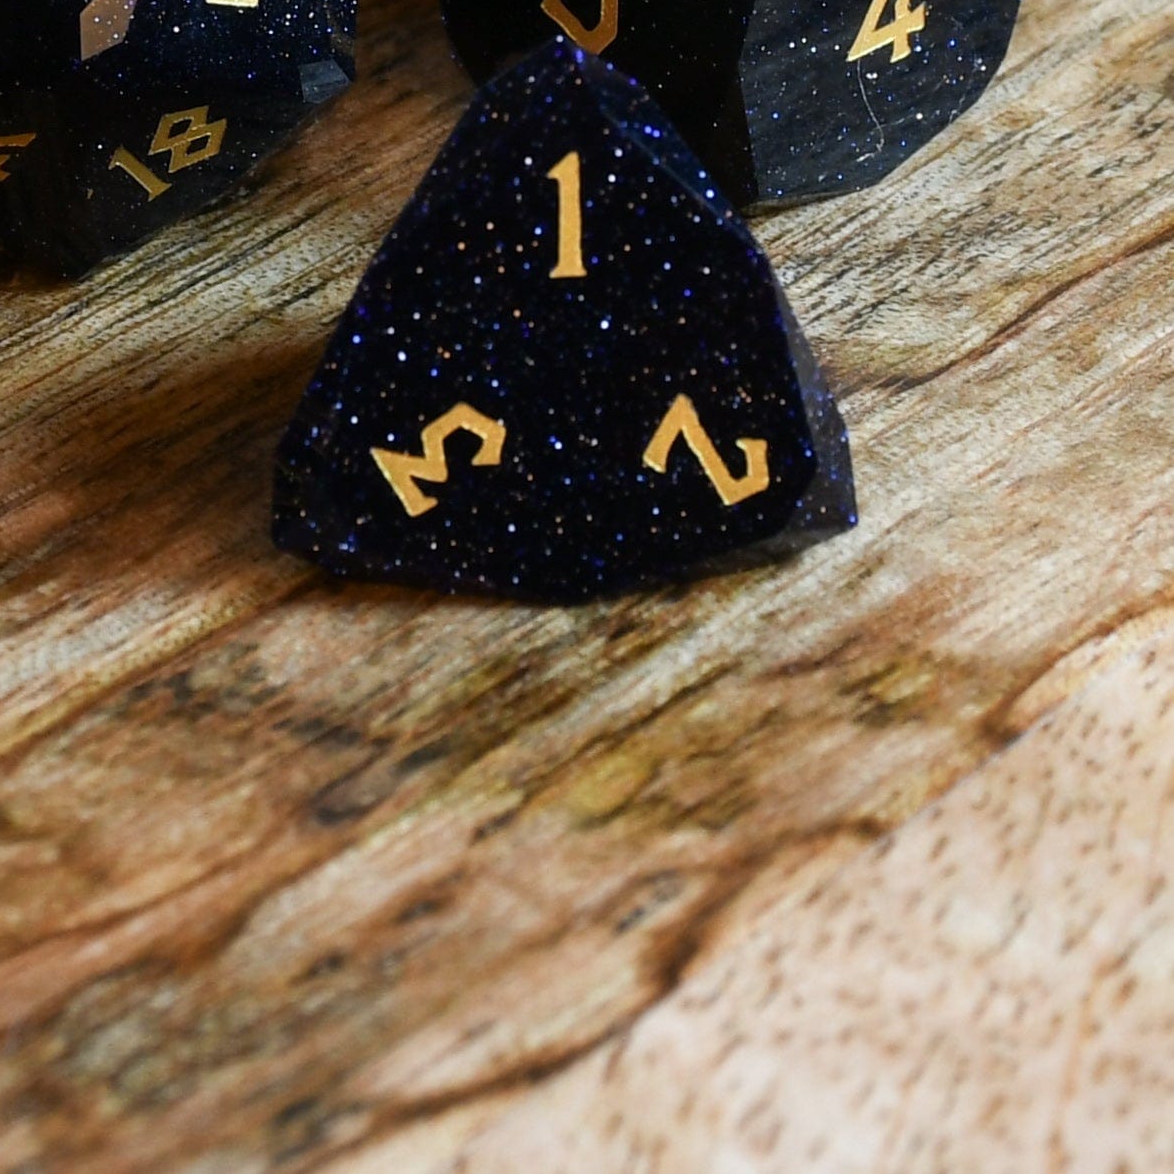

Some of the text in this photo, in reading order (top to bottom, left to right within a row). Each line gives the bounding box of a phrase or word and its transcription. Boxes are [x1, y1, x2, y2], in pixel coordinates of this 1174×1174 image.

[108, 104, 229, 202] 18
[546, 151, 588, 280] 1
[370, 402, 508, 518] 3
[642, 393, 771, 507] 2
